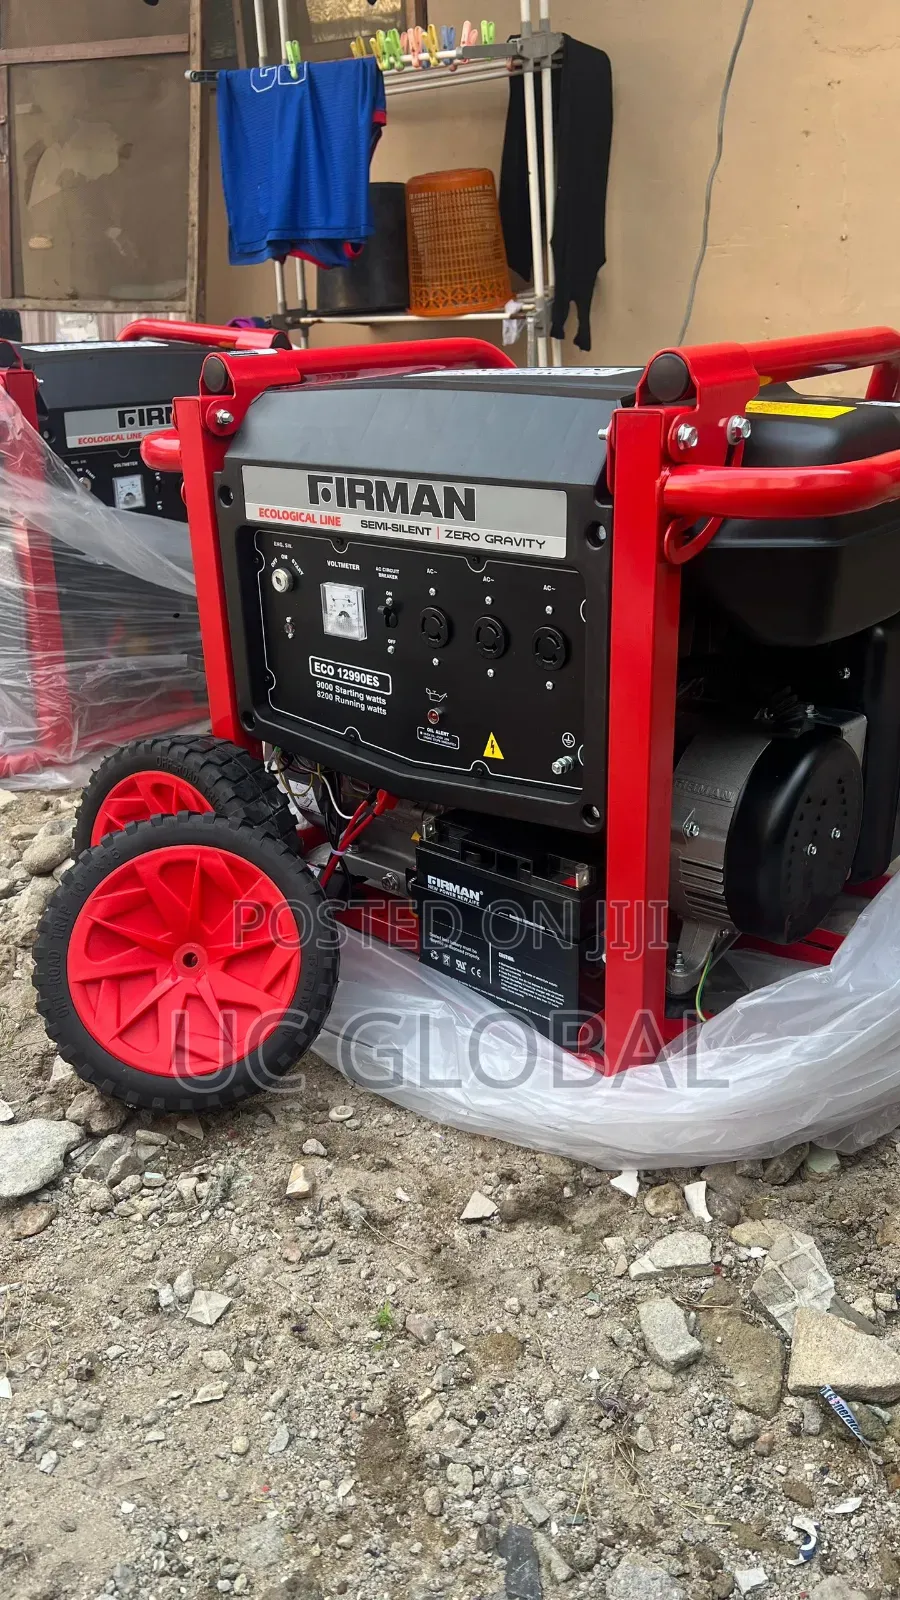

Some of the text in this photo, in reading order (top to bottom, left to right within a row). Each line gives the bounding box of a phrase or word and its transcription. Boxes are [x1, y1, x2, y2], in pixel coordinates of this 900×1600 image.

[78, 432, 143, 445] ECOLOGICAL LINE
[308, 474, 476, 521] FIRMAN
[259, 507, 342, 527] ECOLOGICAL LINE
[360, 519, 546, 549] SEMI-SILENT ZERO GRAVITY
[291, 558, 304, 575] START
[327, 560, 360, 570] VOLTMETER
[314, 661, 380, 687] ECO 12990ES
[316, 680, 387, 705] 9000 Starting watts
[316, 690, 387, 716] 8200 Running watts
